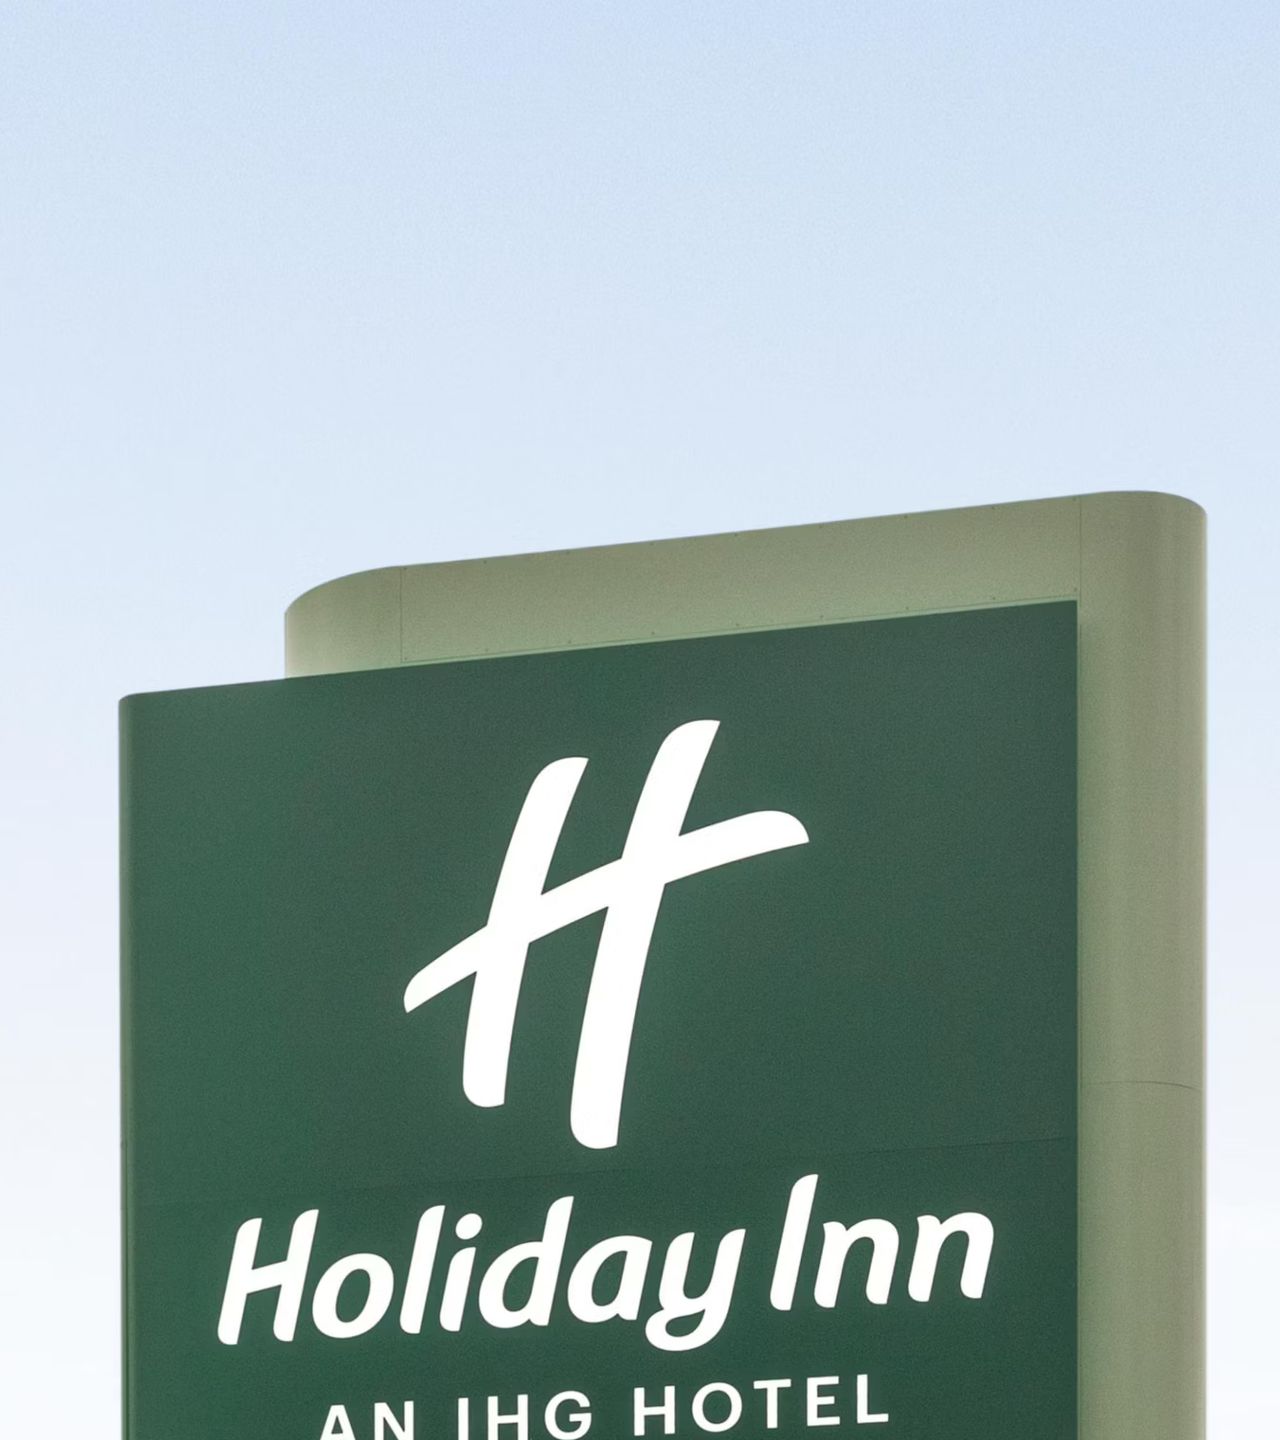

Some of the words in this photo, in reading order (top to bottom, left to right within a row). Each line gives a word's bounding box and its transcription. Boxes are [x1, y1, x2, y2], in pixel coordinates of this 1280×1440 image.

[403, 719, 810, 1150] H
[217, 1195, 746, 1352] Holiday
[769, 1173, 994, 1311] Inn
[633, 1374, 889, 1437] HOTEL
